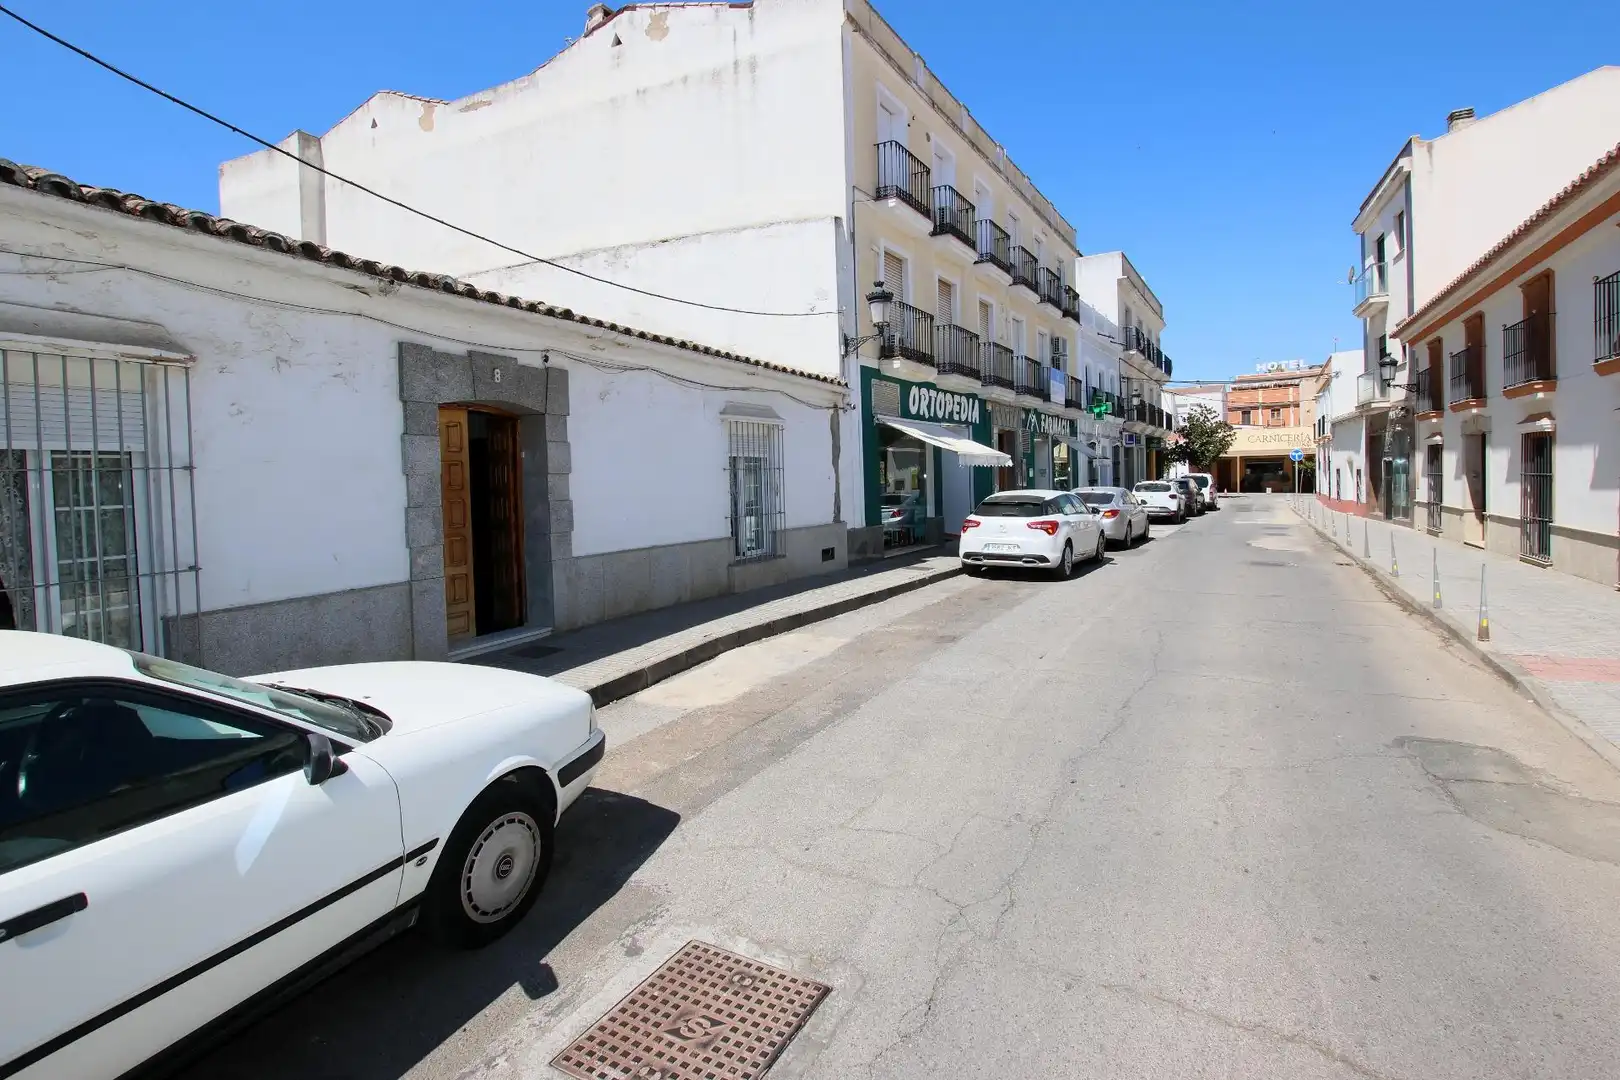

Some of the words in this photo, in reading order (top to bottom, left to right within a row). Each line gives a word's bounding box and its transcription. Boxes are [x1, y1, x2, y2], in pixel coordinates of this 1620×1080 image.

[1256, 360, 1309, 371] HOTEL
[494, 368, 501, 383] 8
[908, 385, 980, 424] ORTOPEDIA
